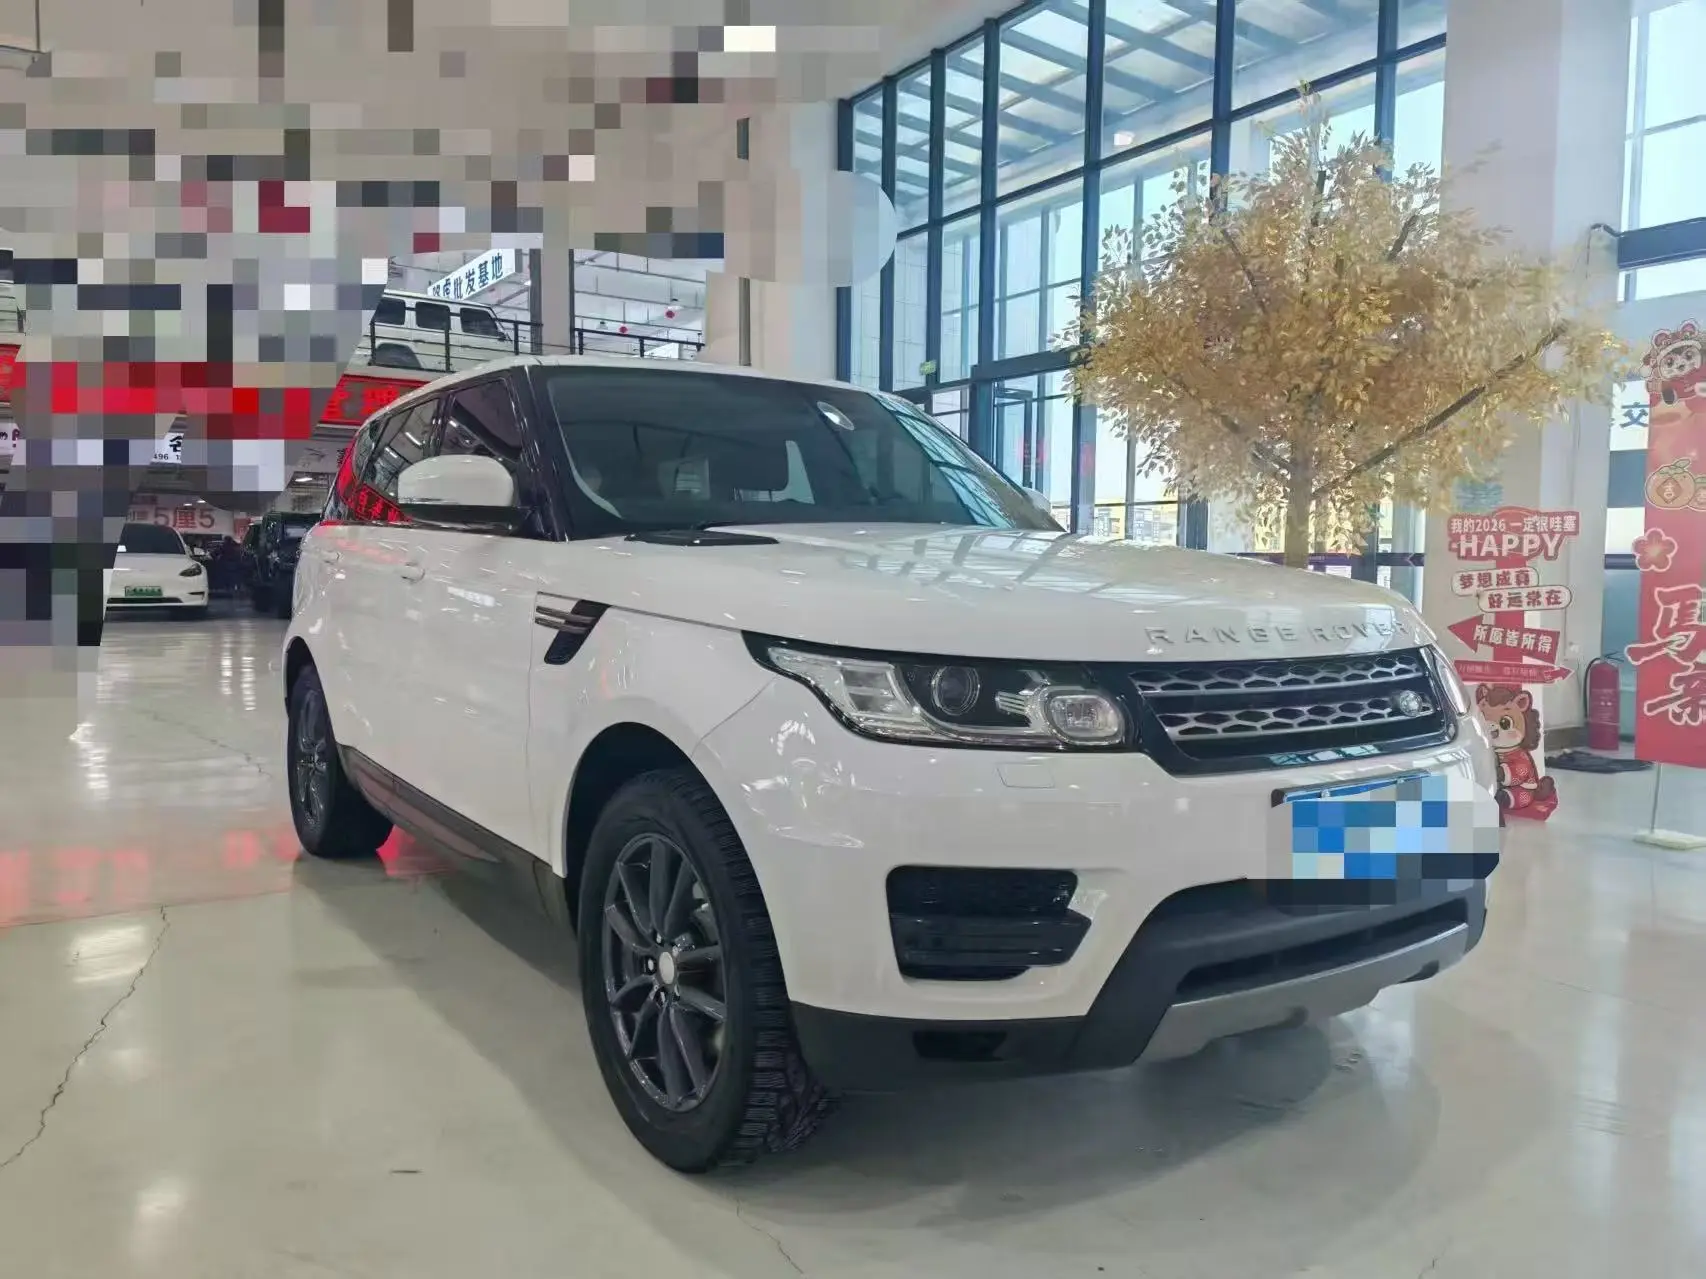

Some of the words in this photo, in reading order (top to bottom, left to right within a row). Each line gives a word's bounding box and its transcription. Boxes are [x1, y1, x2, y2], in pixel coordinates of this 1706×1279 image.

[1460, 533, 1561, 557] HAPPY
[1459, 570, 1530, 589] 梦想成真
[1488, 589, 1562, 609] 好运常在
[1144, 625, 1299, 645] RANGE
[1473, 624, 1553, 654] 所愿皆所得
